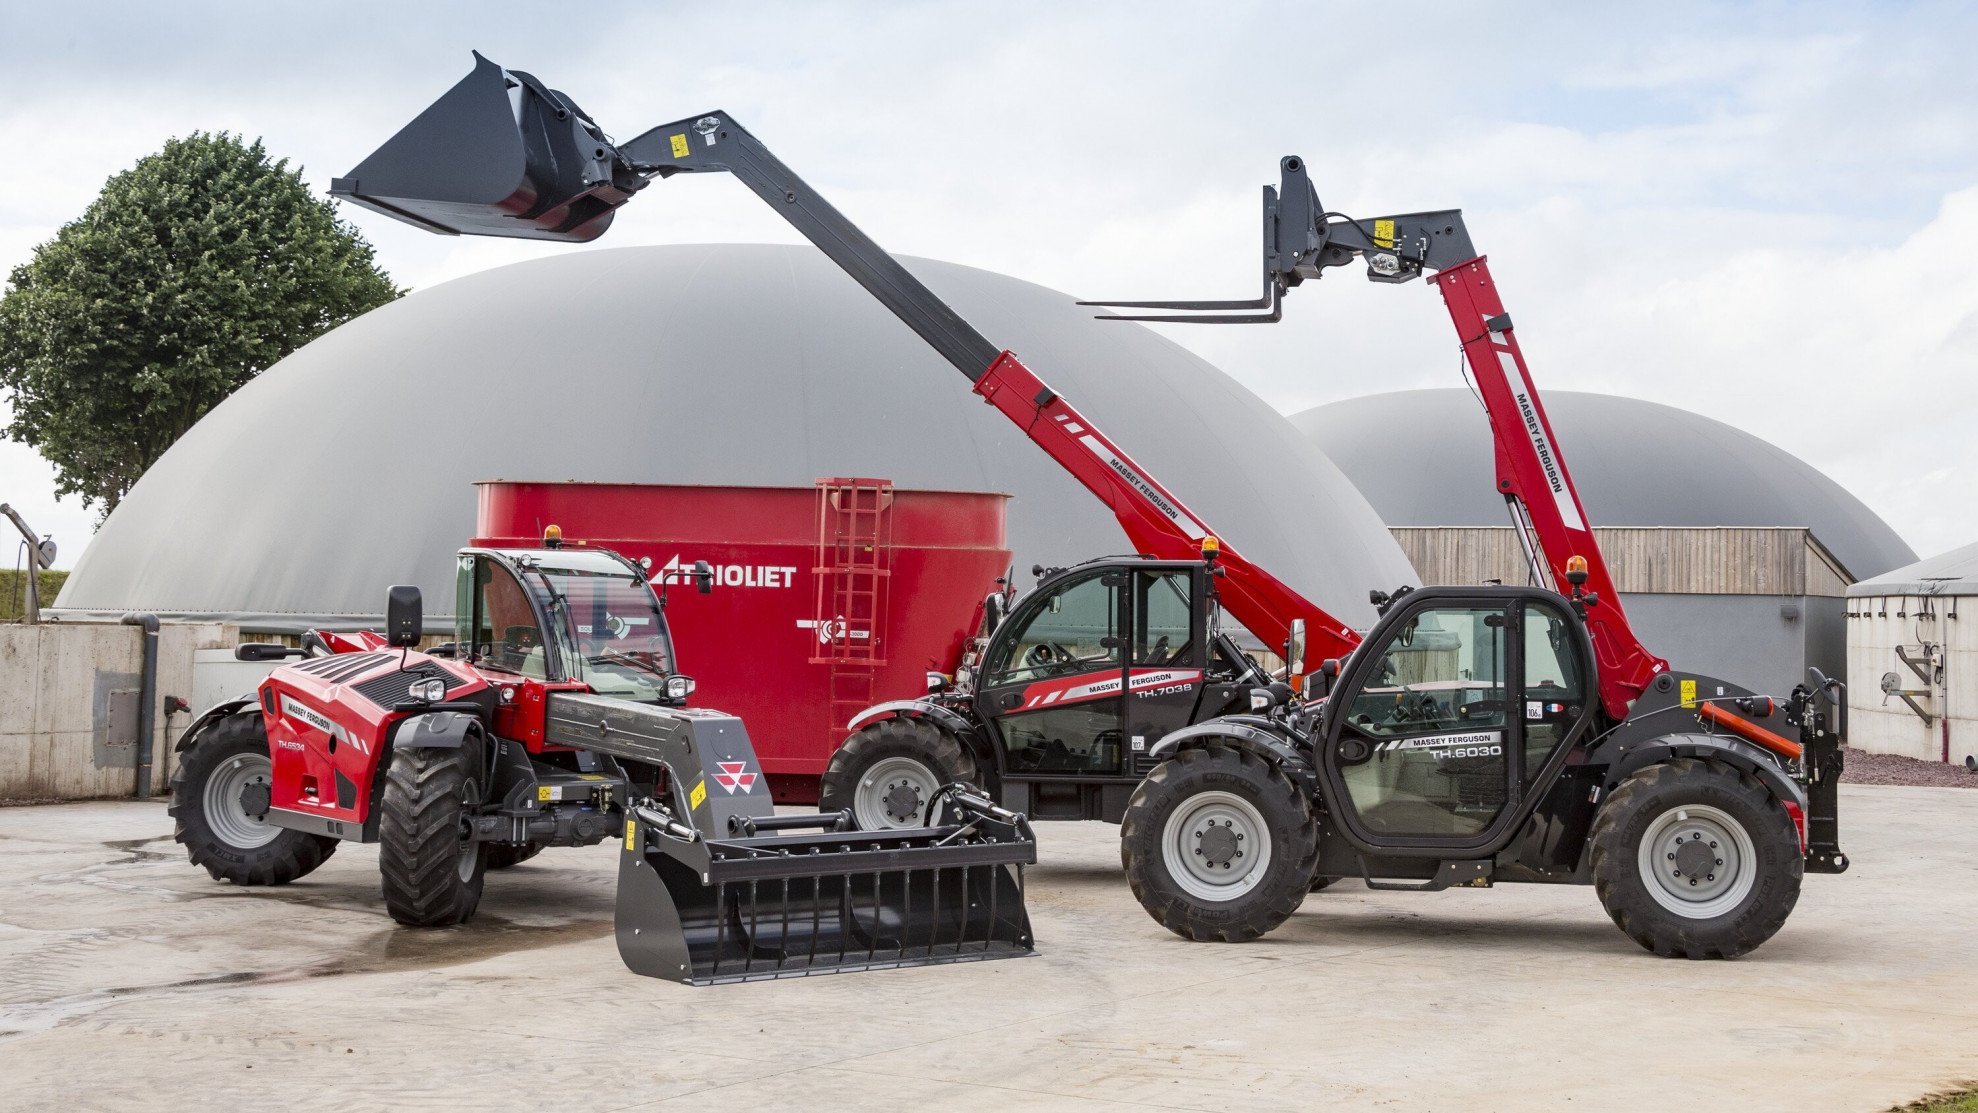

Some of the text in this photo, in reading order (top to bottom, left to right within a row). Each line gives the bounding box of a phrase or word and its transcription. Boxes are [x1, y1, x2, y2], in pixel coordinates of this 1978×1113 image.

[1517, 393, 1563, 493] MASSEY FERGUSON
[1110, 458, 1179, 520] MASSEY FERGUSON
[1088, 673, 1172, 693] MASSEY FERGUSON
[1136, 683, 1193, 699] TH.7038
[288, 703, 331, 731] MASSEY FERGUSON
[1413, 734, 1491, 747] MASSEY FERGUSON
[1429, 745, 1502, 760] TH.6030
